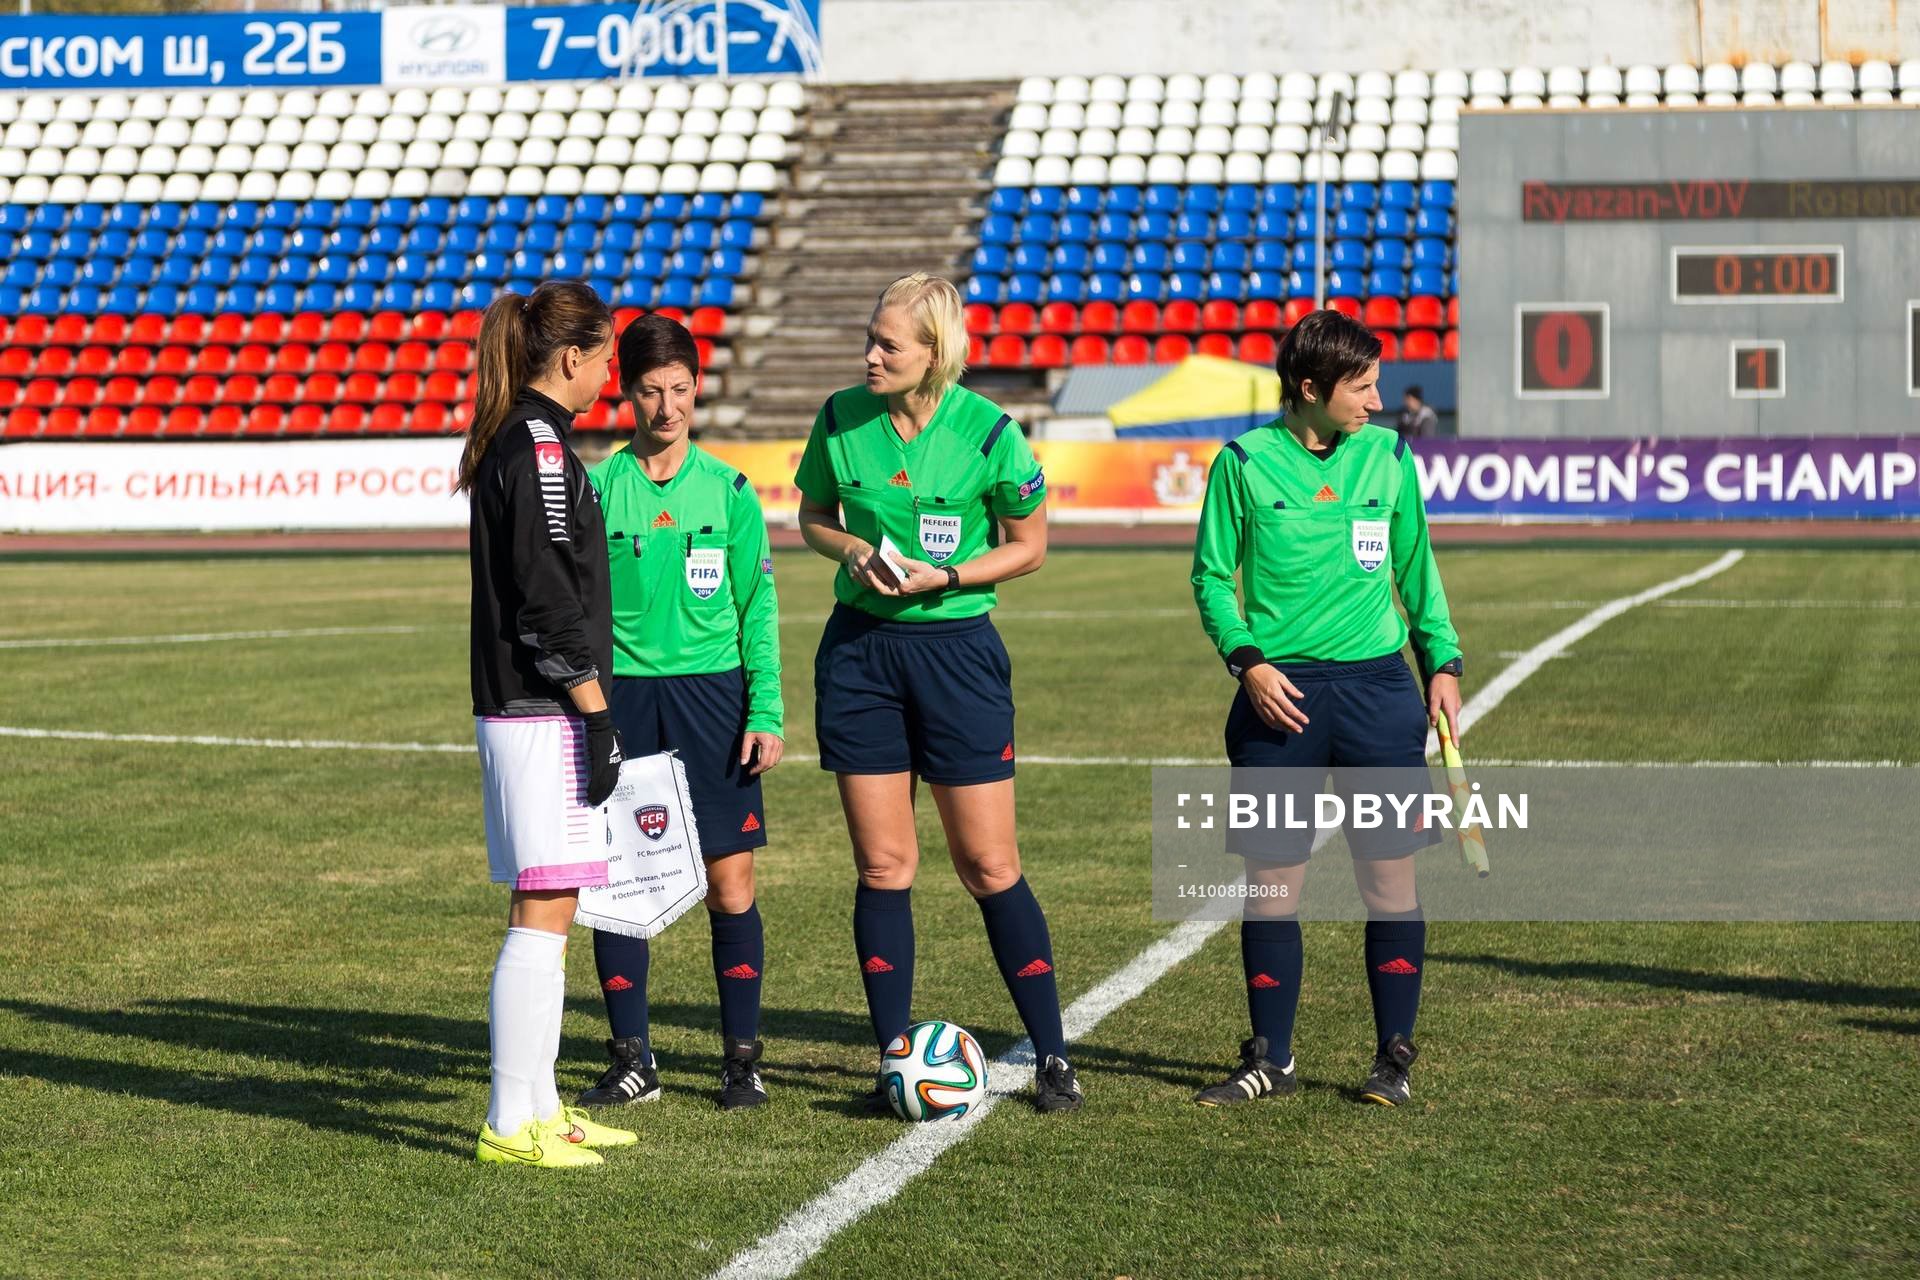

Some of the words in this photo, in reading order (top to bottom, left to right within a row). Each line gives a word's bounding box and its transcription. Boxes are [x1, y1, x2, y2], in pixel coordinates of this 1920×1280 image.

[242, 21, 347, 77] 22Б
[1523, 178, 1749, 225] Ryazan-VDV
[1533, 311, 1594, 389] 0
[1747, 348, 1768, 390] 1
[125, 469, 320, 498] СИЛЬНАЯ
[1414, 453, 1691, 502] WOMEN'S
[1704, 452, 1917, 501] CHAMP
[922, 518, 958, 527] REFEREE
[924, 532, 955, 544] FIFA
[1358, 540, 1384, 551] FIFA
[690, 568, 719, 579] FIFA
[697, 588, 712, 596] 2014
[640, 812, 665, 826] FCR
[636, 850, 646, 858] FC
[646, 843, 682, 857] Rosengård
[607, 854, 622, 863] VDV
[634, 874, 660, 884] Ryazan,
[660, 868, 683, 879] Russia
[617, 888, 645, 899] October
[648, 884, 666, 894] 2014
